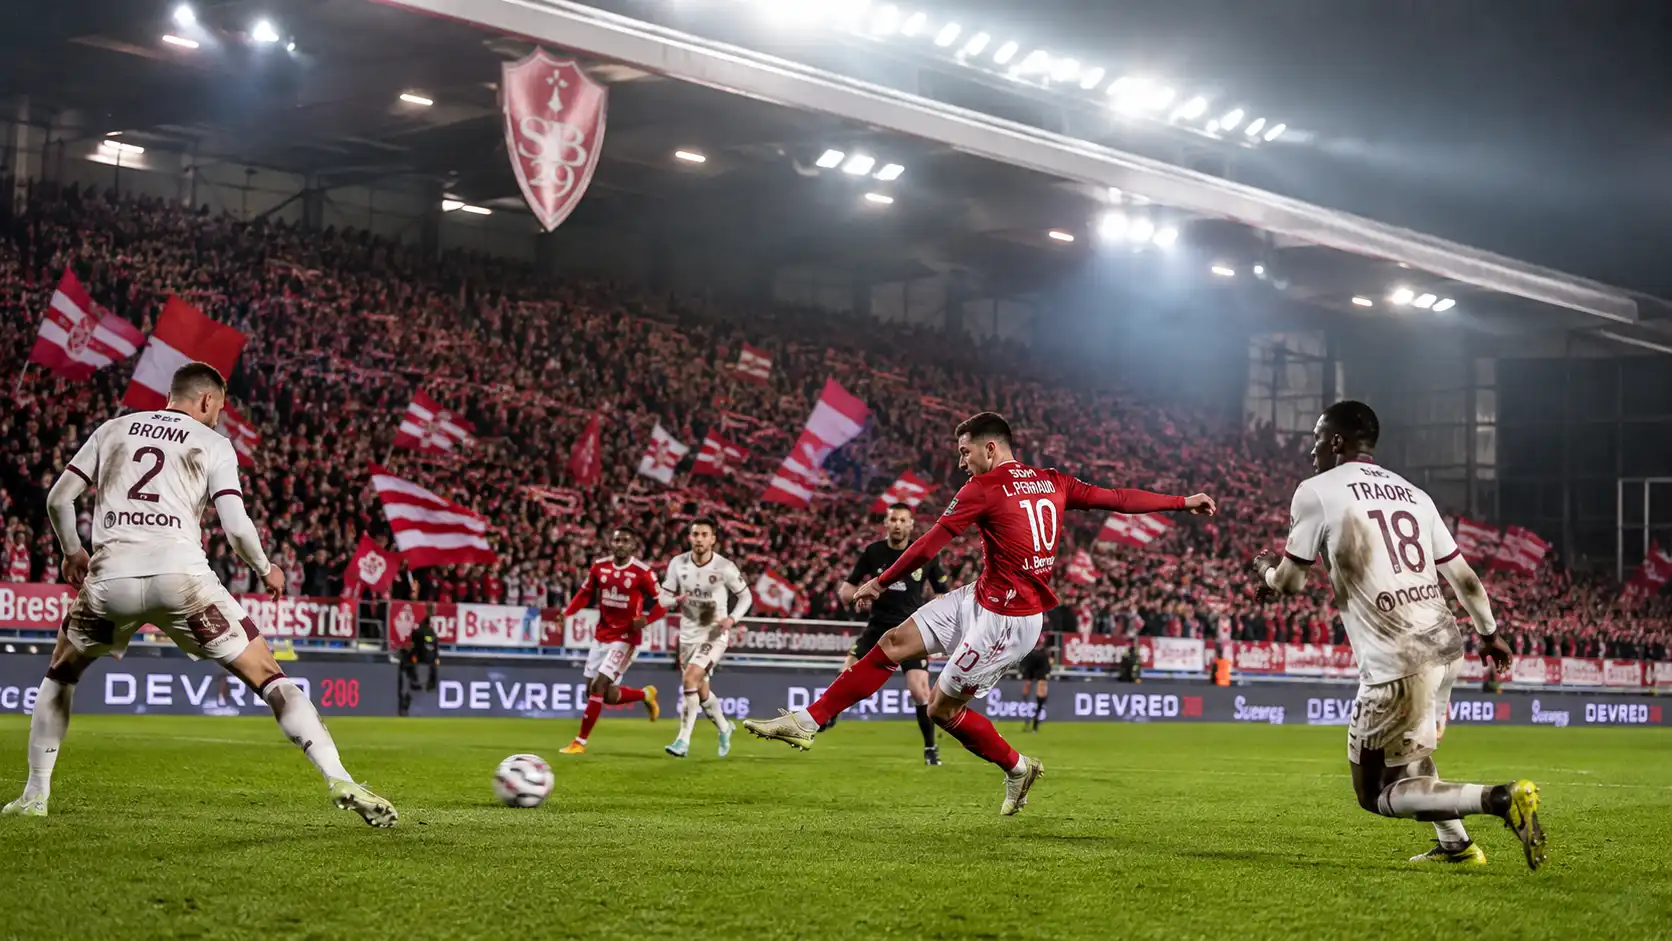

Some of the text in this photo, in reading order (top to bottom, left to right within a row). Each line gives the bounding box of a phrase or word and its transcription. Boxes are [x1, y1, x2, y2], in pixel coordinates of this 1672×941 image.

[128, 422, 190, 444] BRONN
[127, 446, 165, 503] 2
[1347, 482, 1417, 504] TRAORE
[118, 511, 182, 529] nacon
[1019, 498, 1057, 552] 10
[1367, 509, 1426, 575] 18
[1395, 582, 1443, 606] nacon
[104, 672, 311, 707] DEVRD
[1075, 692, 1179, 717] DEVRED
[1307, 698, 1355, 719] DEV
[1448, 701, 1494, 720] VRED
[1585, 703, 1648, 722] DEVRED
